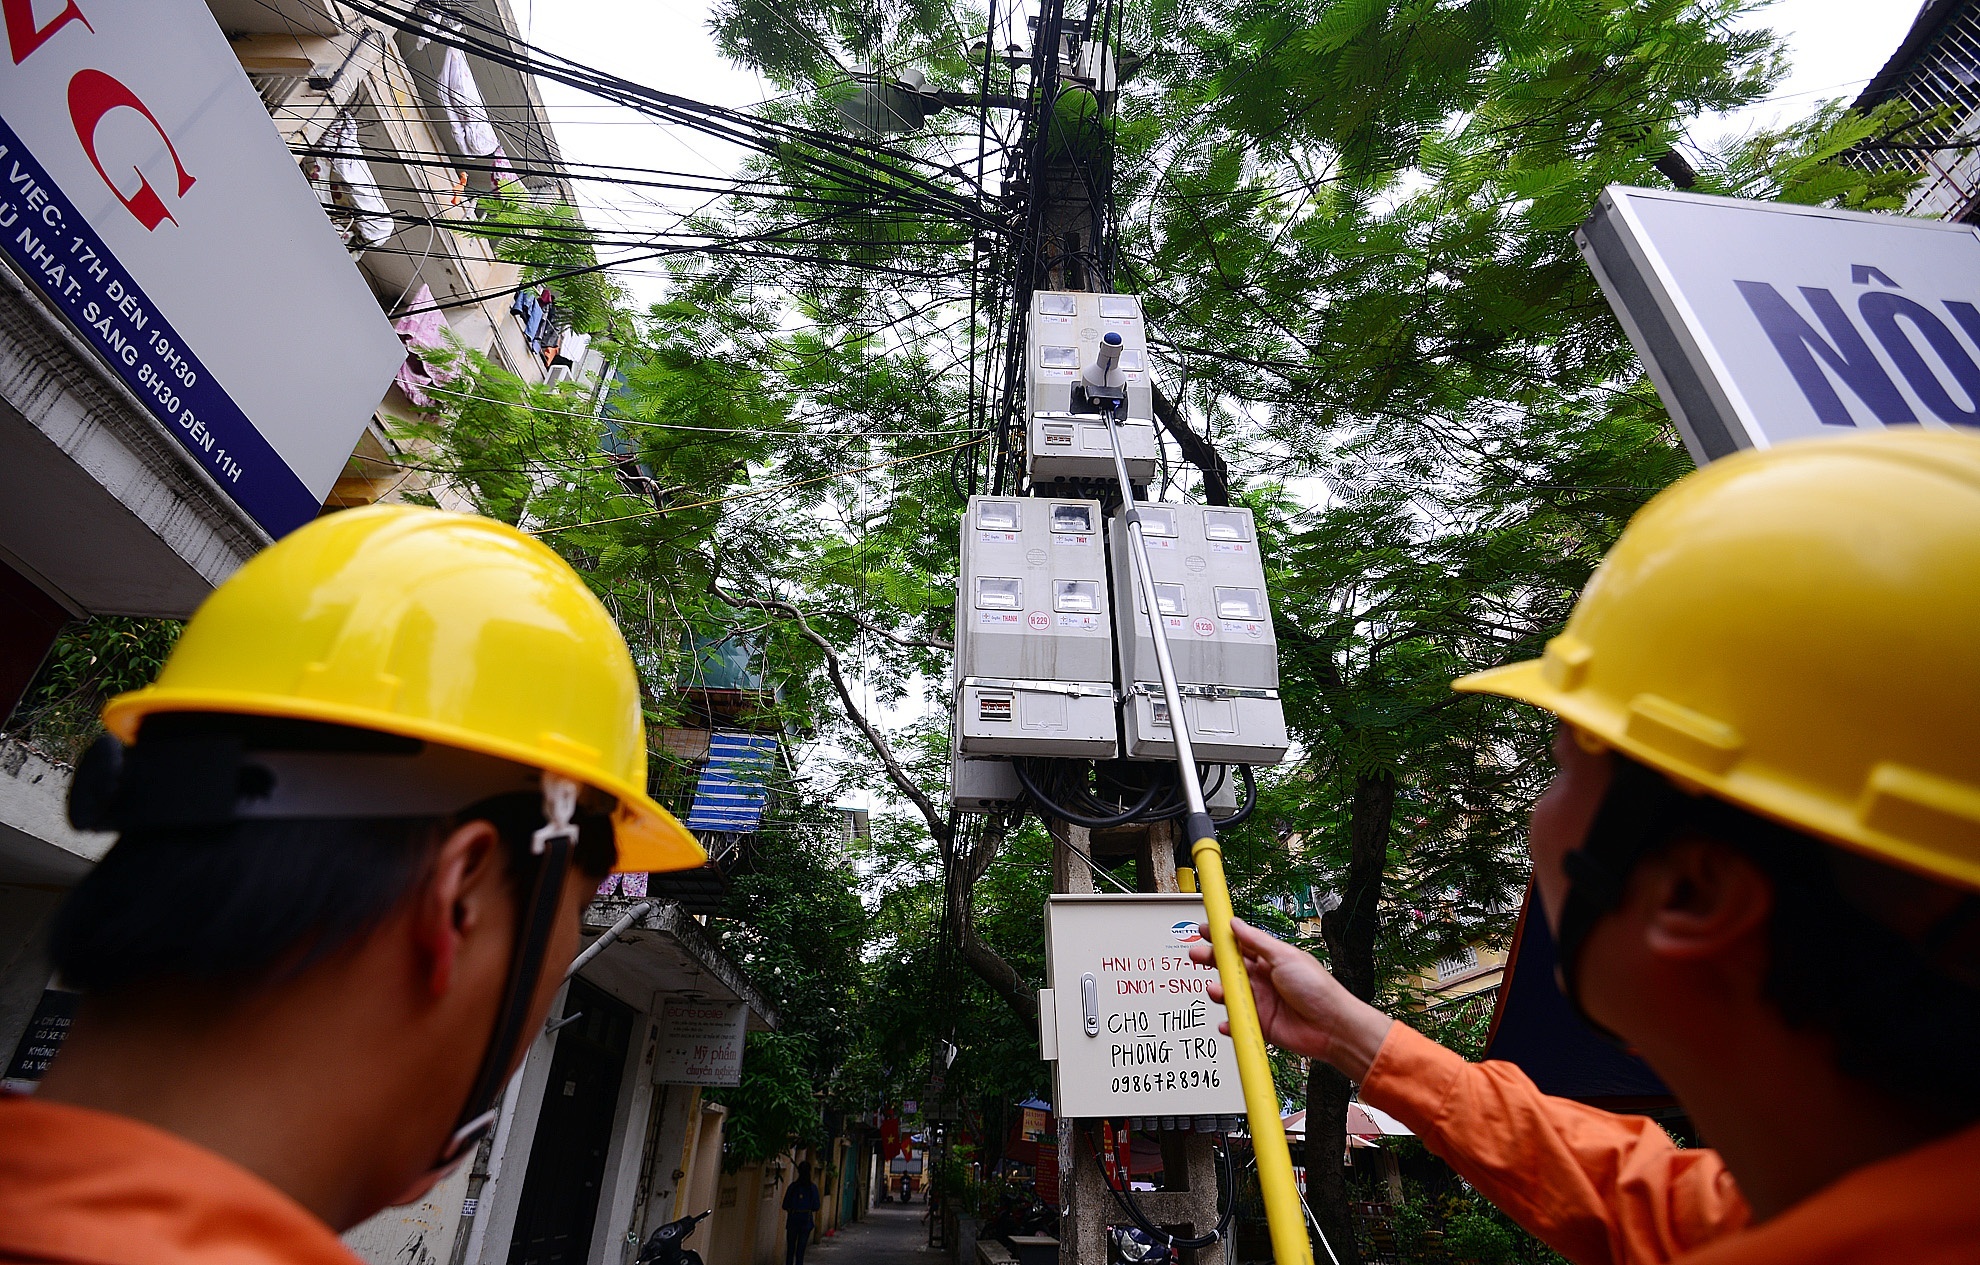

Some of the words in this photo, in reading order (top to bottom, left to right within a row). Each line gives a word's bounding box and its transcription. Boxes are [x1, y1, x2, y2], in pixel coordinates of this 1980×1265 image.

[10, 160, 66, 236] VIỆC:
[70, 236, 109, 283] 17H
[106, 279, 149, 331] ĐẾN
[148, 329, 197, 389] 19H30
[16, 227, 82, 304] NHẬT:
[83, 301, 139, 366] SÁNG
[137, 363, 180, 413] 8H30
[179, 409, 216, 452] ĐẾN
[215, 449, 243, 483] 11H
[1037, 616, 1048, 625] 229
[1201, 623, 1213, 632] 230
[1107, 1011, 1149, 1034] CHO
[1158, 999, 1206, 1032] THUÊ
[1179, 1037, 1217, 1063] TRỌ
[21, 1060, 34, 1070] RA
[1111, 1068, 1220, 1093] 0986728916
